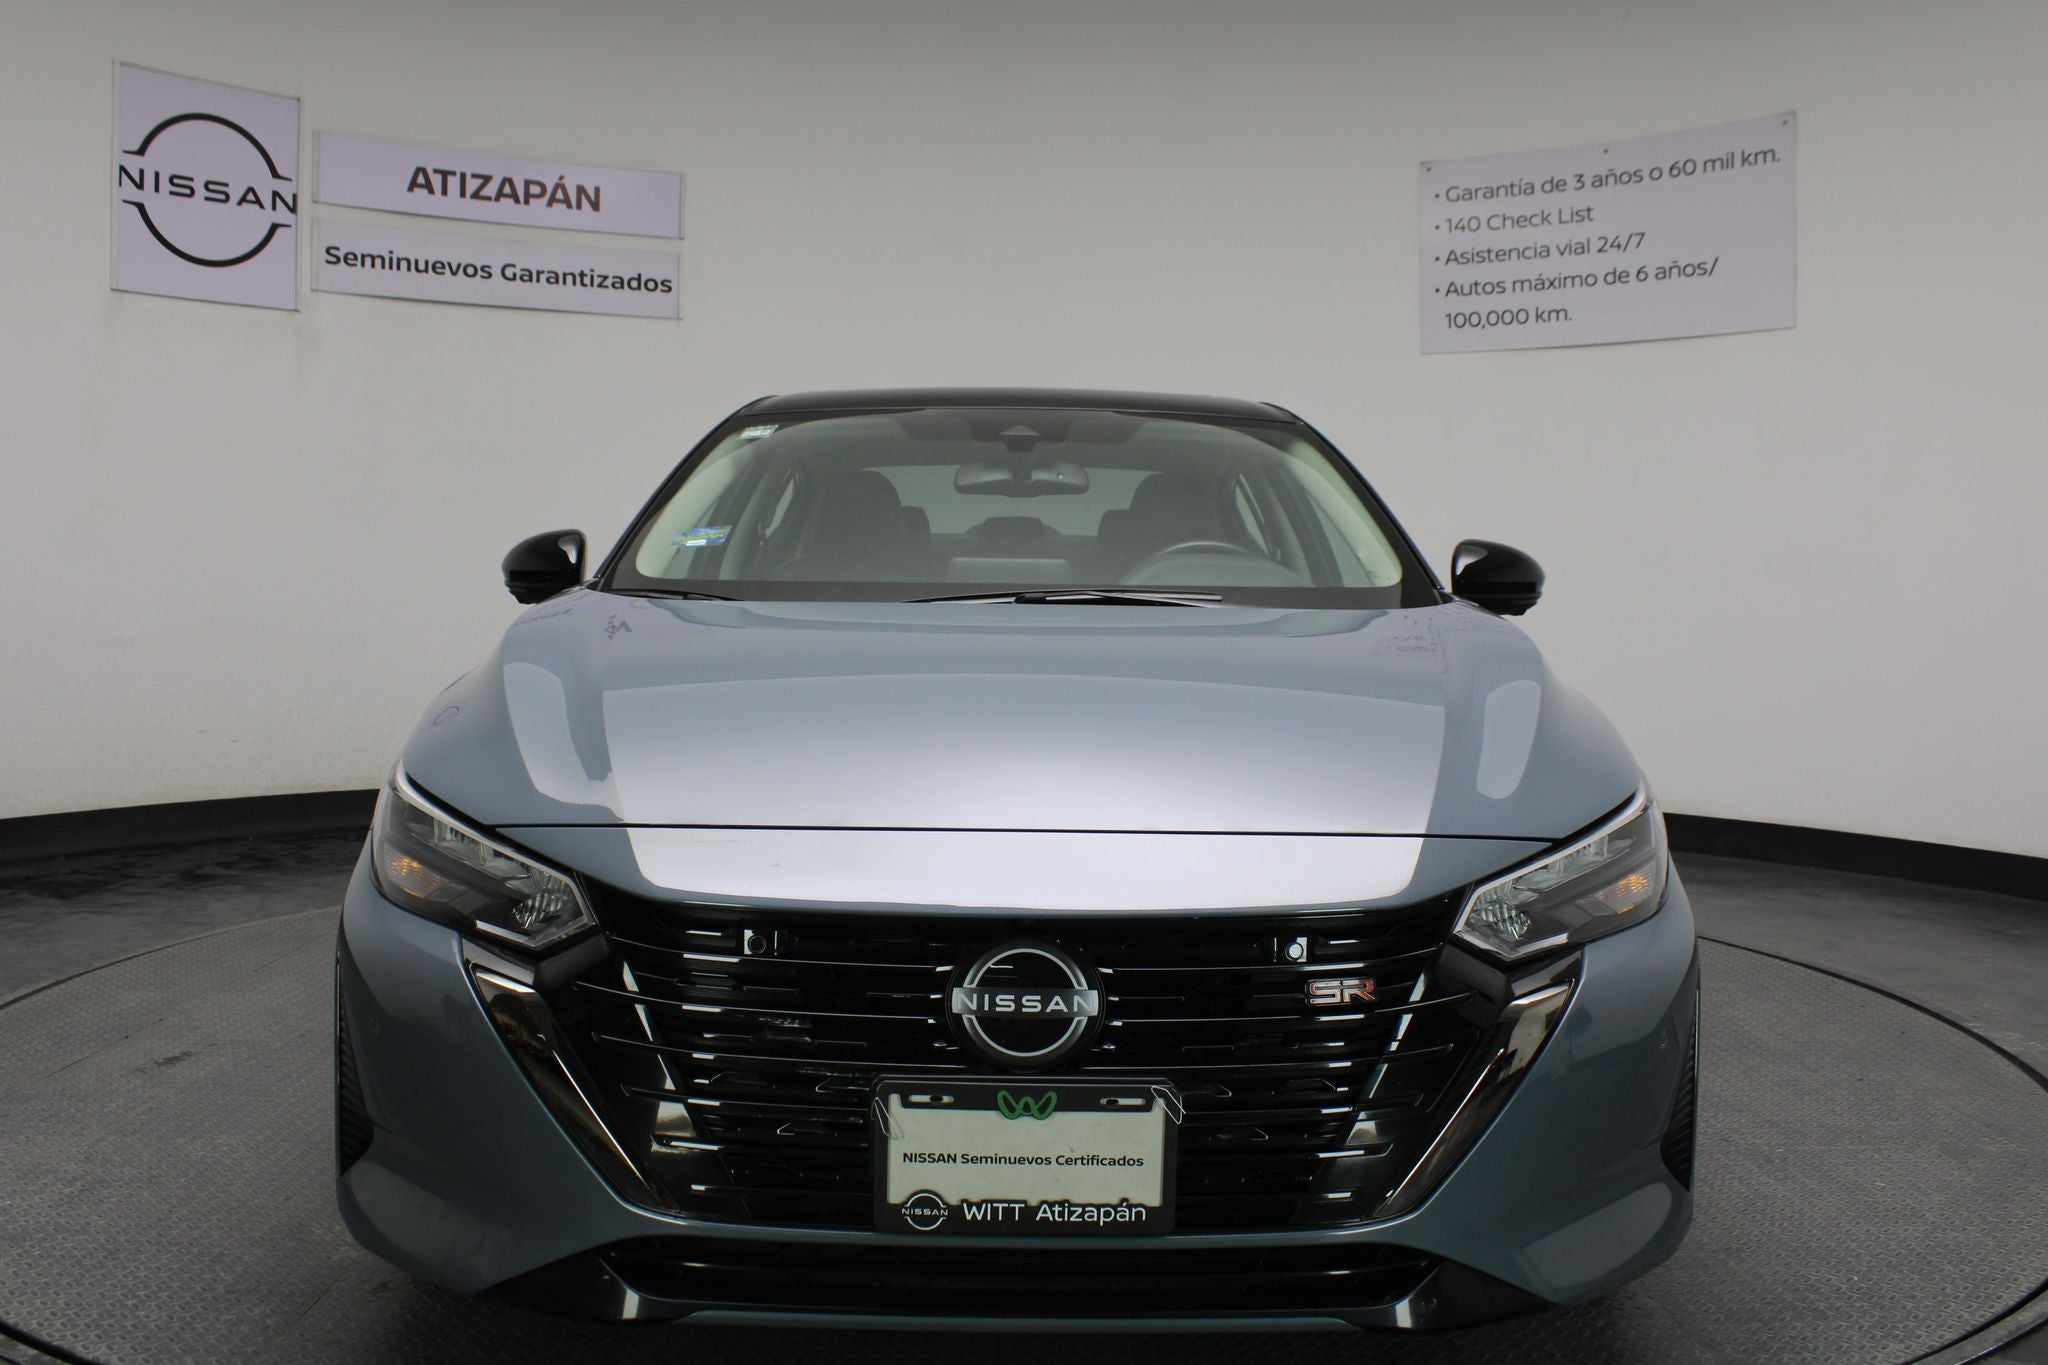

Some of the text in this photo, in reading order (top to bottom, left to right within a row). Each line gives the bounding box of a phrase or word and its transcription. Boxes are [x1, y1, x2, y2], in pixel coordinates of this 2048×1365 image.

[118, 164, 298, 214] NISSAN
[406, 165, 602, 213] ATIZAPÁN
[1445, 146, 1781, 203] Garantía de 3 años o 60 mil km.
[1445, 205, 1595, 234] 140 Check List
[1444, 231, 1646, 266] Asistencia vial 24/7
[324, 244, 674, 294] Seminuevos Garantizados
[1444, 256, 1720, 298] Autos máximo de 6 años/
[1445, 305, 1573, 331] 100,000 km.
[955, 992, 1096, 1013] NISSAN
[1306, 978, 1376, 1005] SR
[902, 1151, 1144, 1167] NISSAN Seminuevos Certificados
[901, 1206, 949, 1216] NISSAN
[962, 1202, 1147, 1226] WITT Atizapán
